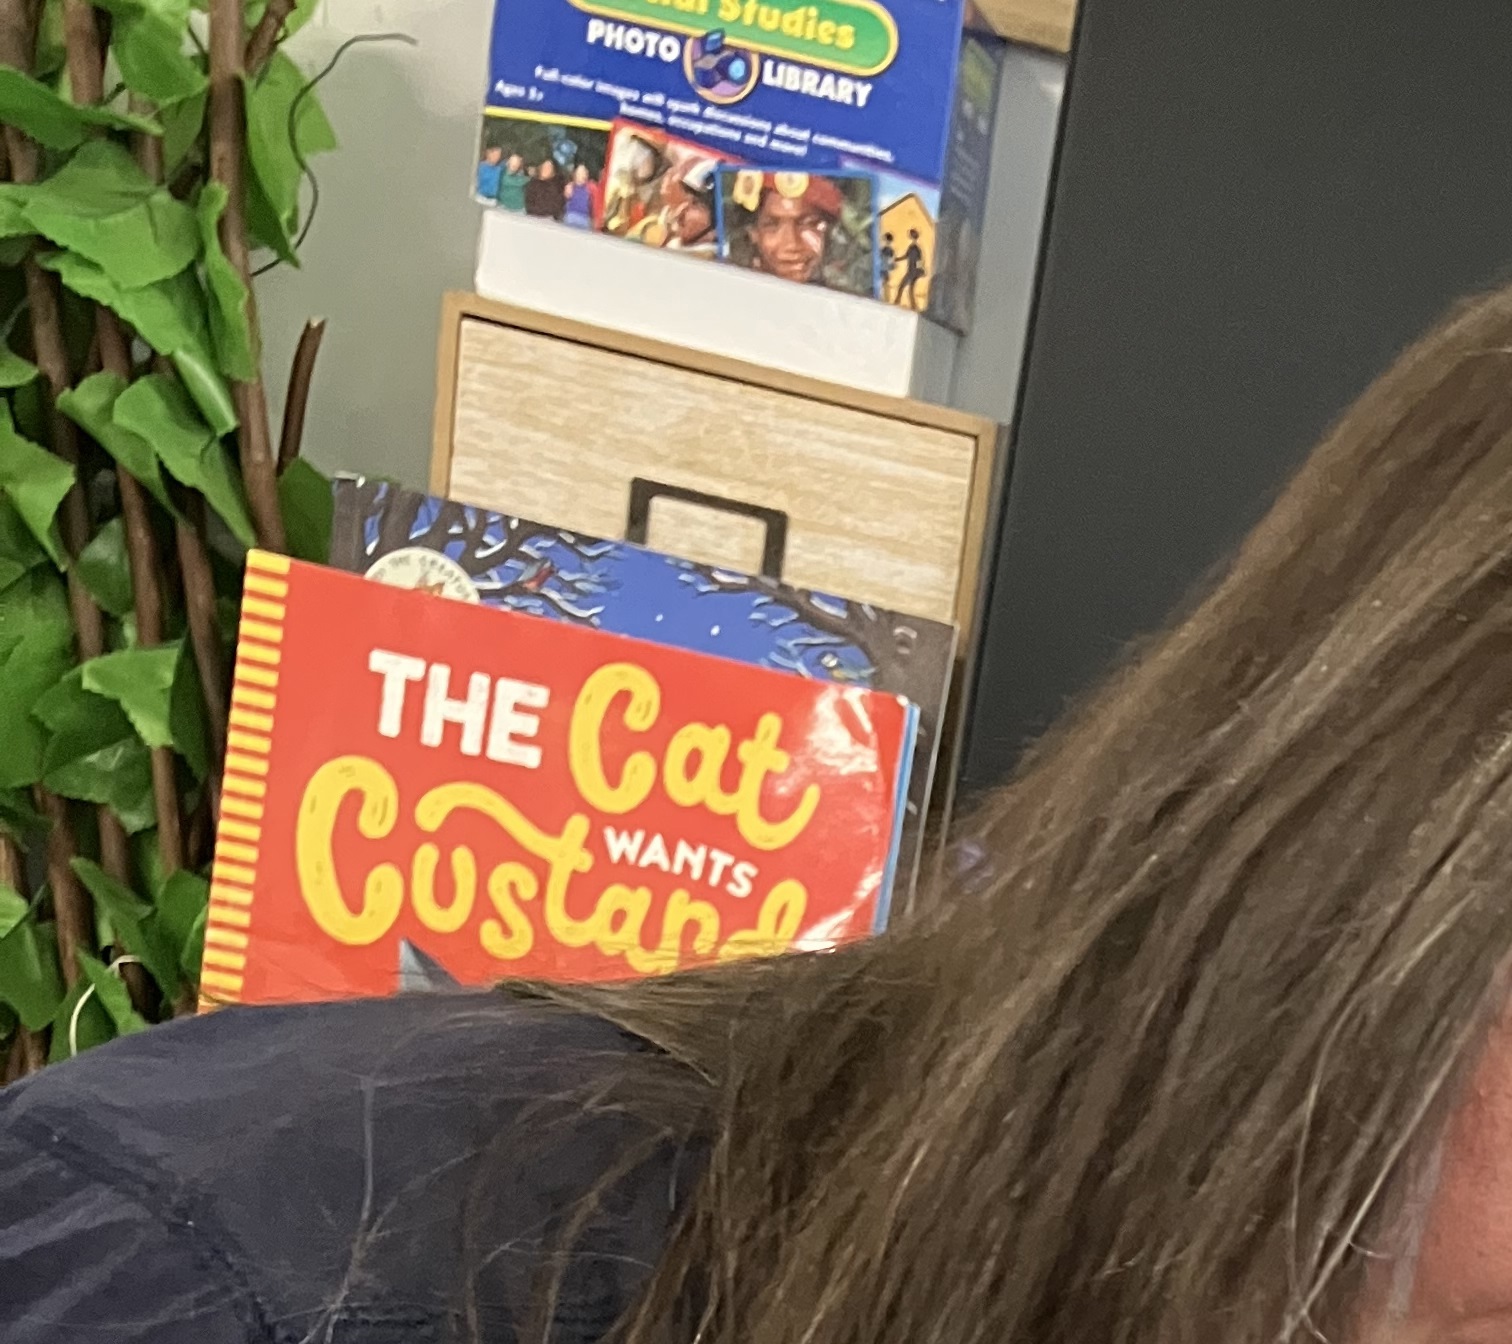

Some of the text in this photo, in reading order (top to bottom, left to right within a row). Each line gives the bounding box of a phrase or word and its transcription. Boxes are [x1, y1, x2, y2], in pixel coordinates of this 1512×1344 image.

[586, 18, 873, 108] PHOTO LIBRARY
[717, 0, 856, 50] Studies
[368, 648, 821, 851] THE Cat
[296, 755, 807, 976] Custard
[603, 826, 758, 899] WANTS
